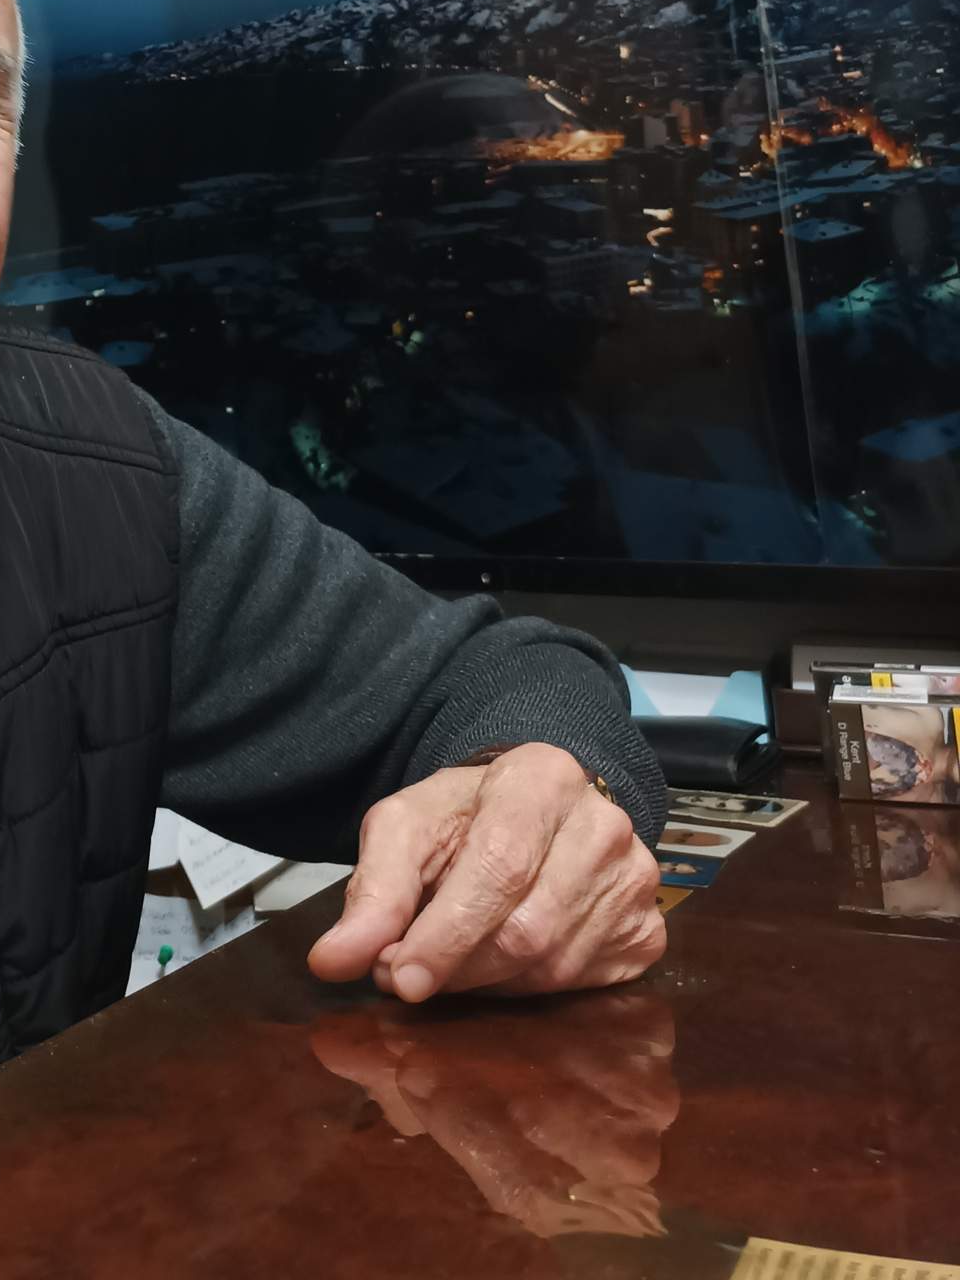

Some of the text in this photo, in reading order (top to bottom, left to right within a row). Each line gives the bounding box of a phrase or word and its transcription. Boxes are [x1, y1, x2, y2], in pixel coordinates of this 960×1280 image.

[840, 731, 849, 760] Range
[849, 739, 861, 765] Kent
[842, 761, 852, 782] Blue
